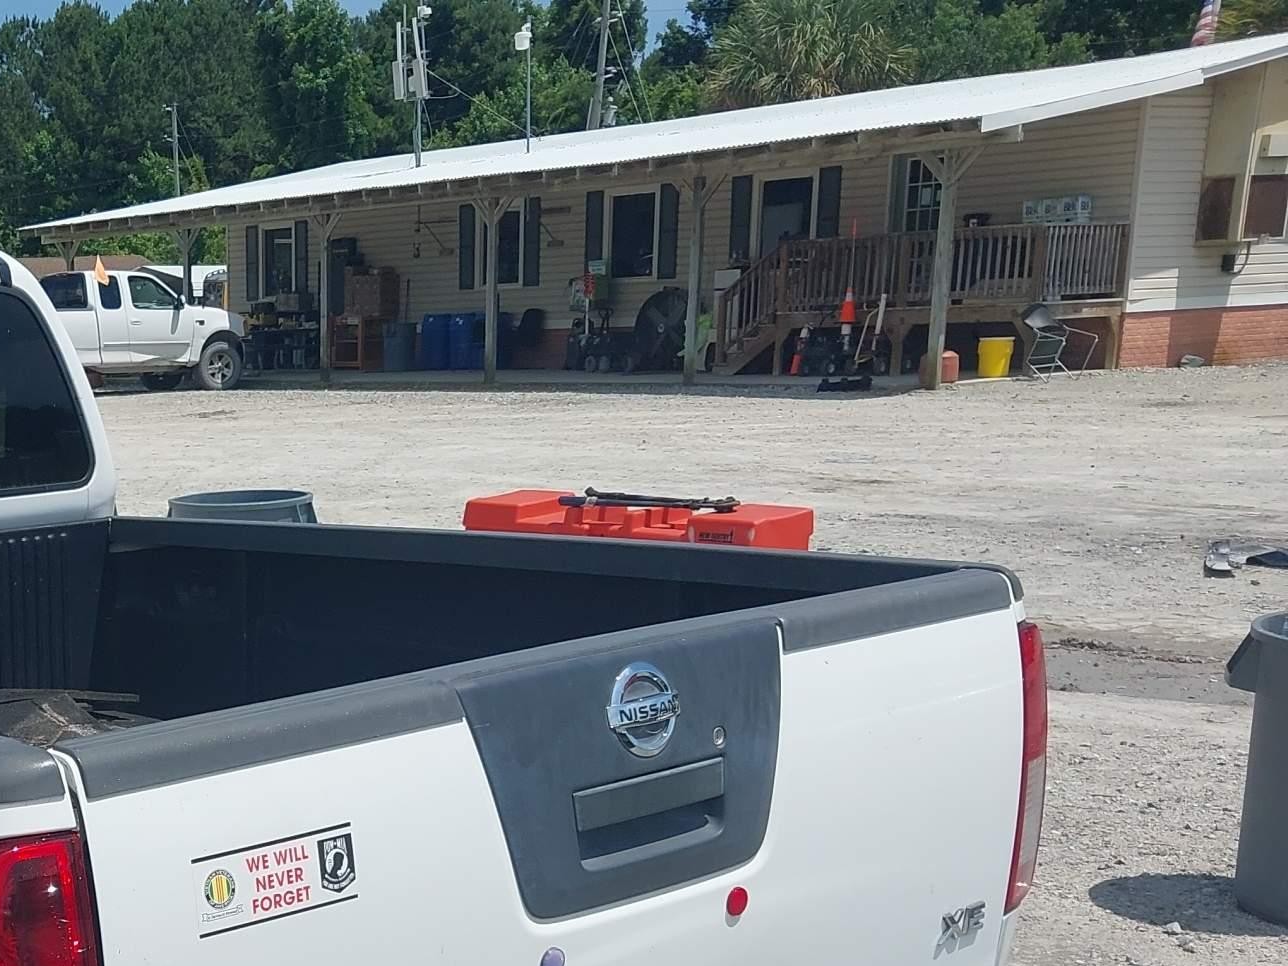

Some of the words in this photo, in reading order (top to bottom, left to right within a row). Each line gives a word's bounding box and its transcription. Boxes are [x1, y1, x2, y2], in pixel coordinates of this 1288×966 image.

[619, 694, 678, 722] NISSAN
[246, 854, 270, 873] WE
[273, 845, 309, 866] WILL
[256, 867, 304, 892] NEVER
[252, 885, 311, 914] FORGET
[937, 900, 986, 945] XE
